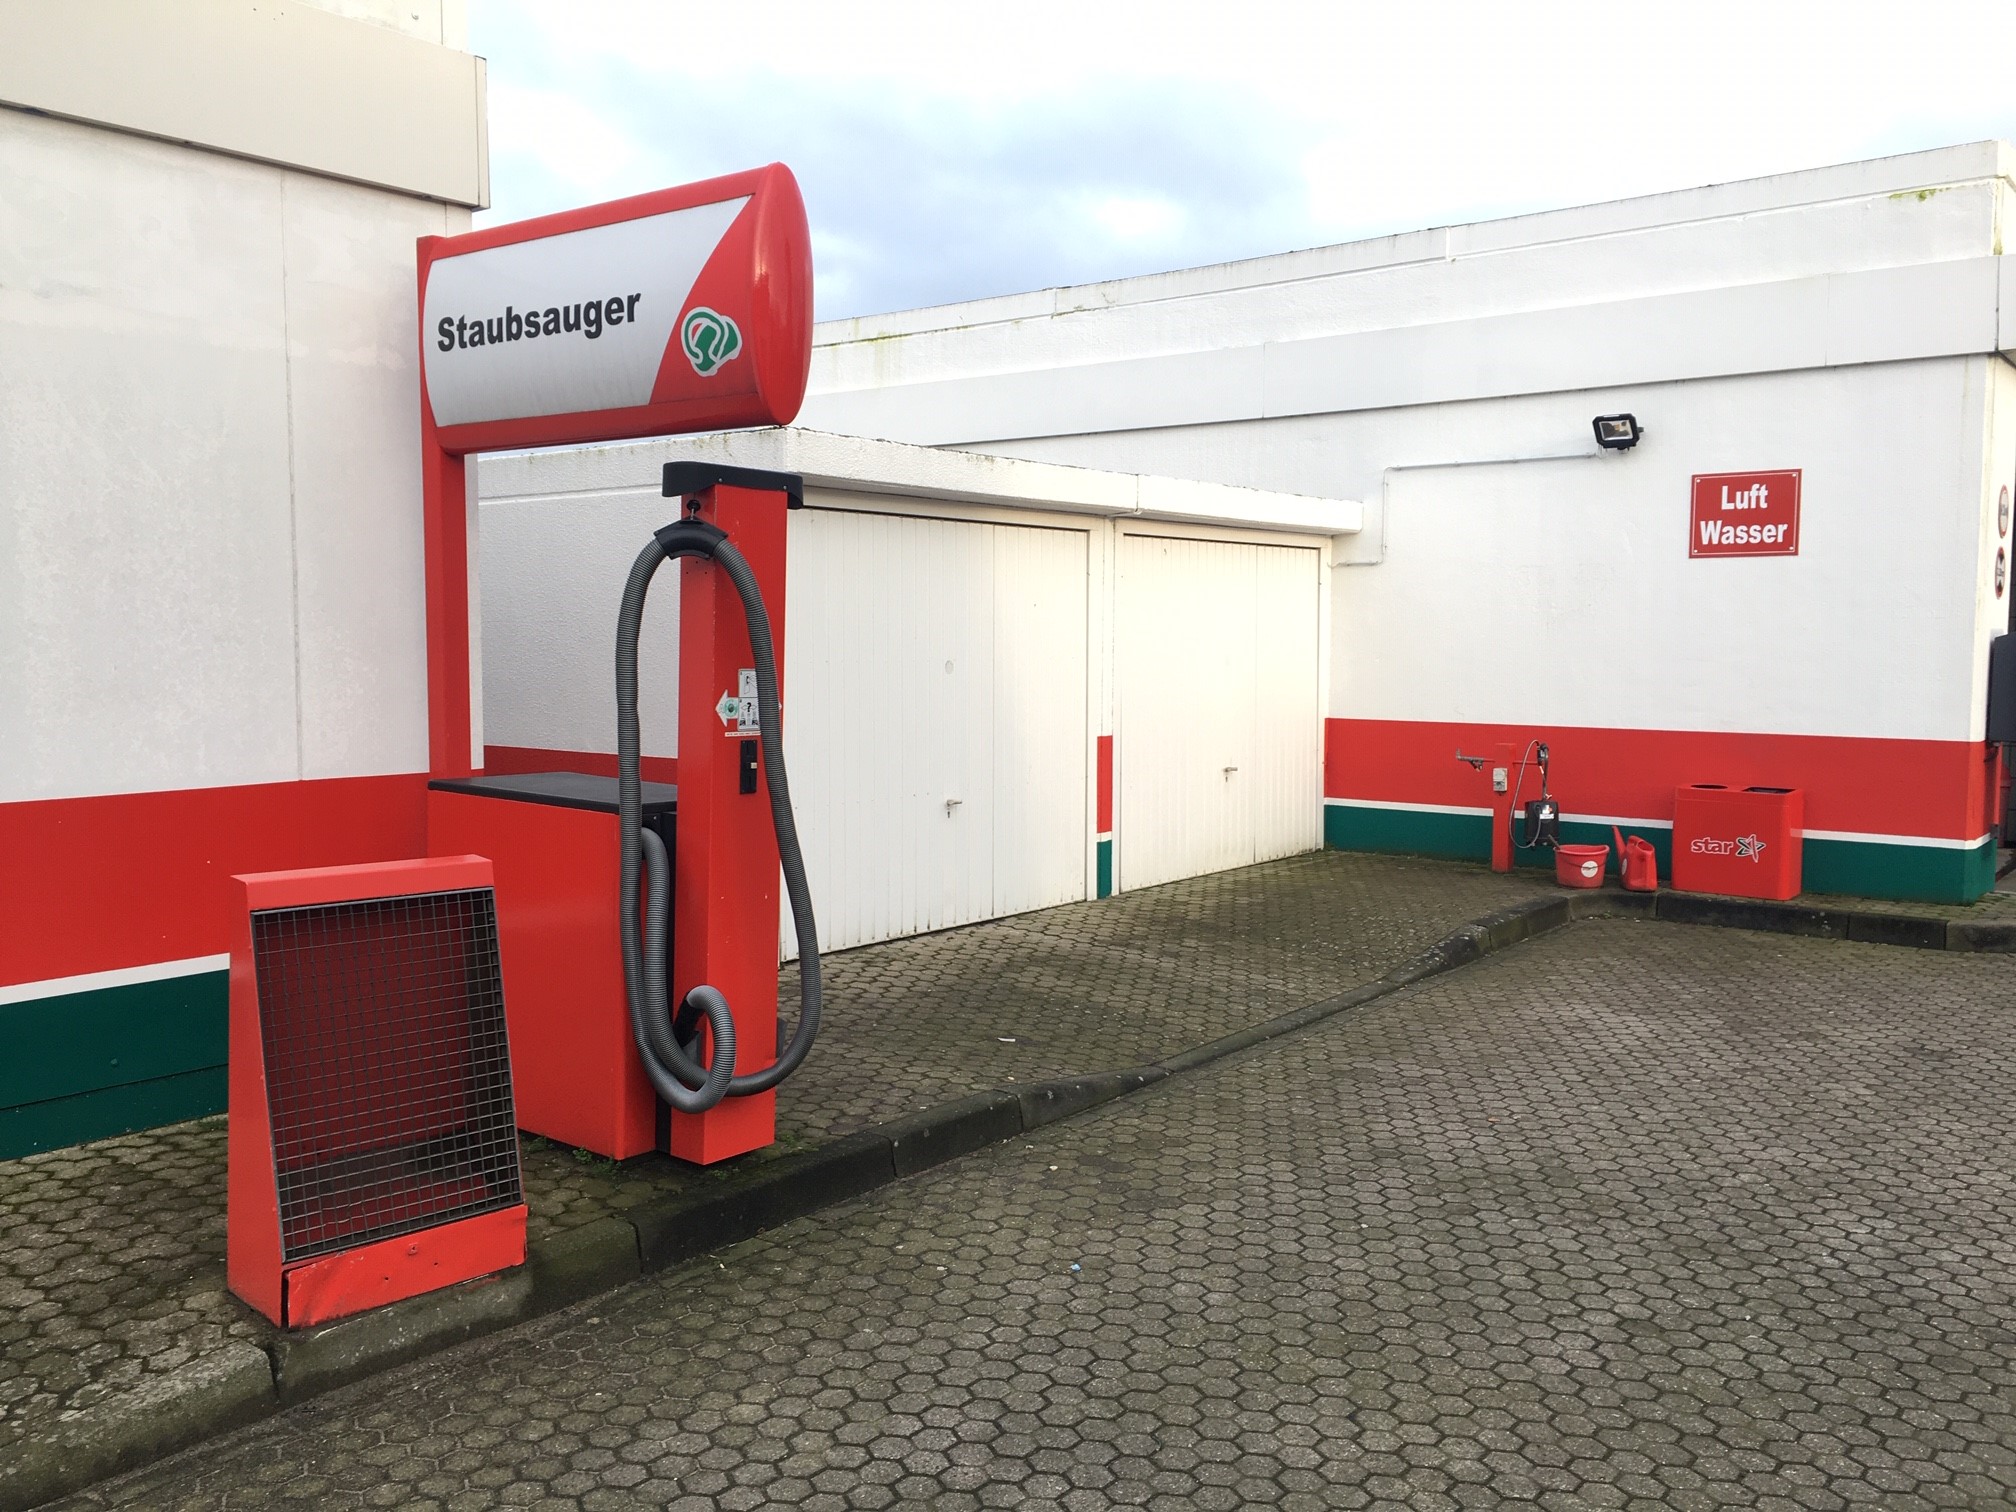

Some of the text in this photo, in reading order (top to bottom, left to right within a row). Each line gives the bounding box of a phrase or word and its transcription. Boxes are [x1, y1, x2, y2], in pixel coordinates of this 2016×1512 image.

[437, 292, 642, 352] Staubsauger
[1721, 483, 1769, 511] Luft
[1700, 519, 1789, 545] Wasser
[1690, 836, 1734, 855] star
